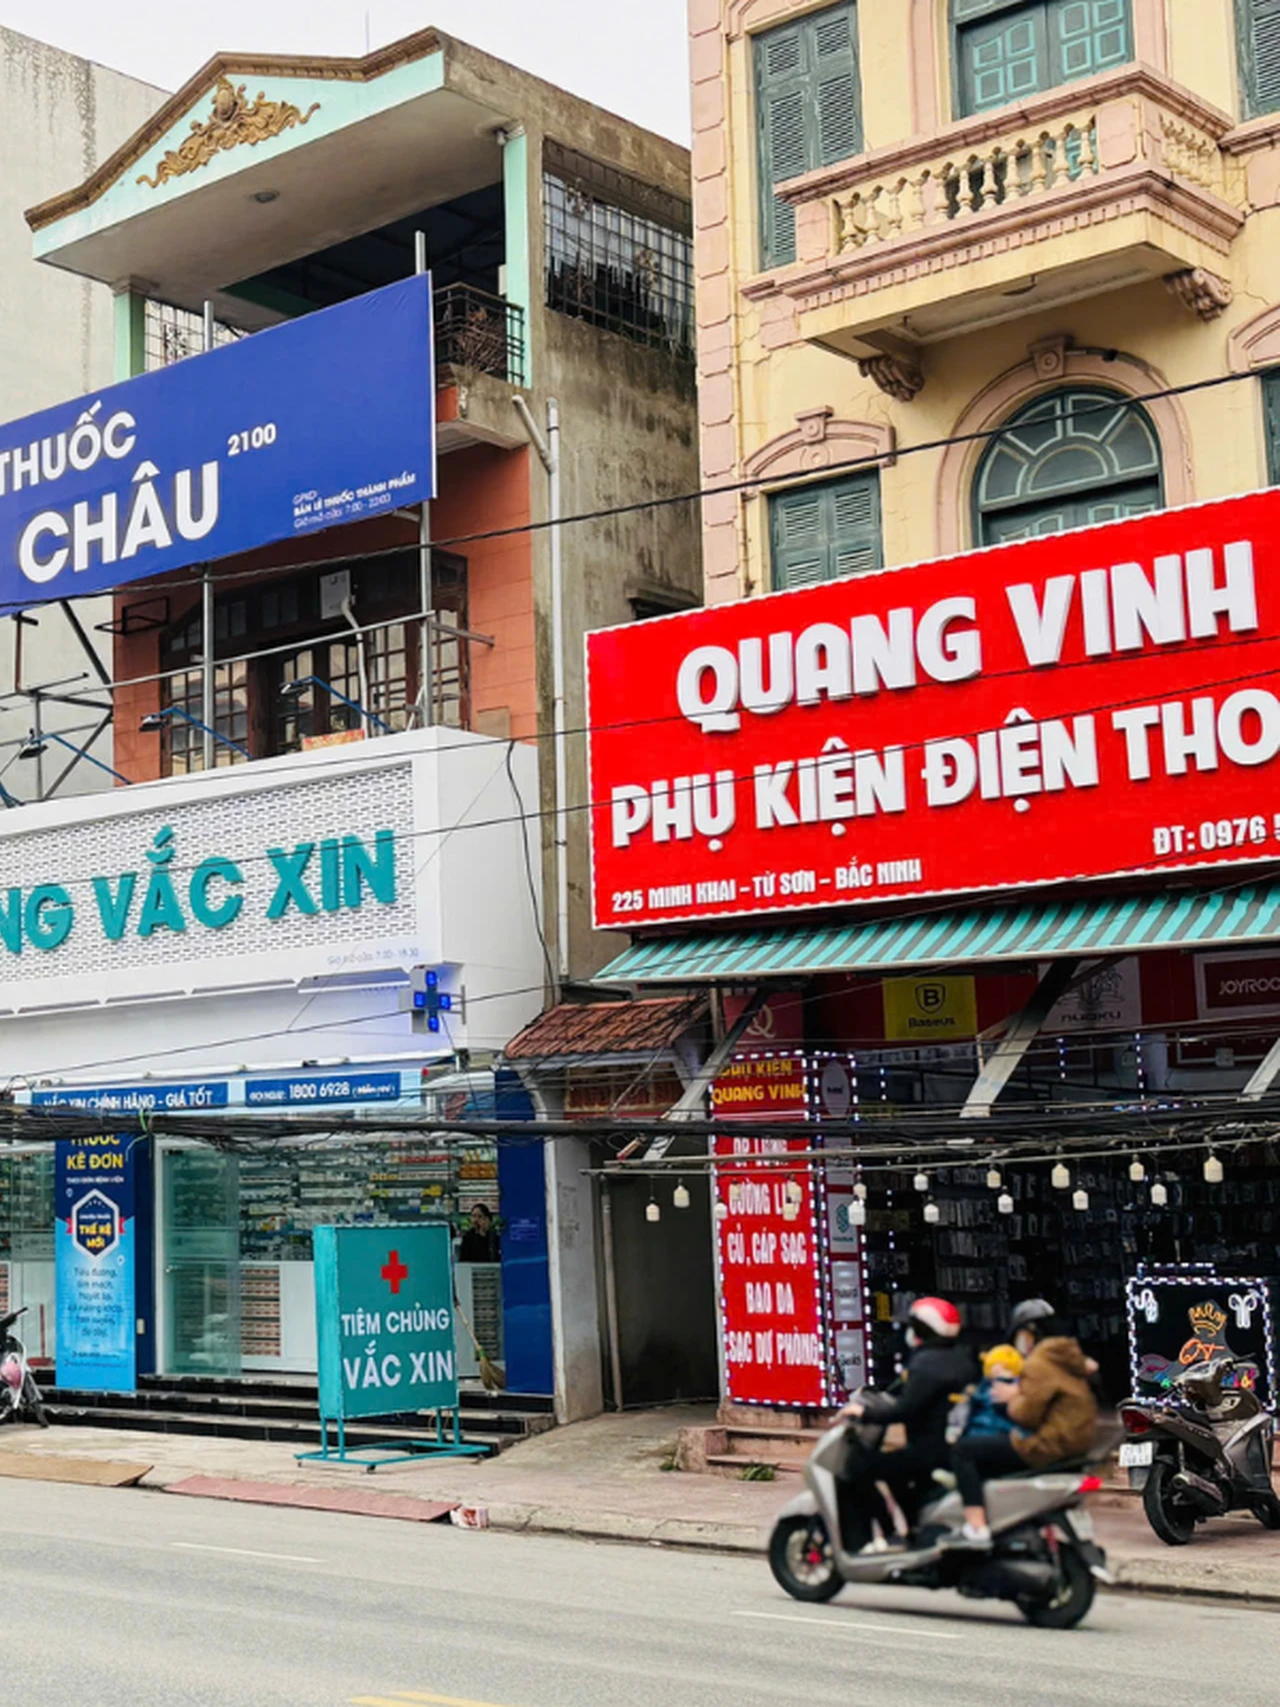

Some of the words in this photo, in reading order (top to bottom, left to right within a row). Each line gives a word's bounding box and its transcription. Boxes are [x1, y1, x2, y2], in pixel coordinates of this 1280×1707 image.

[228, 423, 277, 457] 2100
[18, 460, 220, 584] CHÂU
[677, 596, 982, 734] QUANG
[1006, 540, 1258, 665] VINH
[611, 769, 736, 852] PHỤ
[755, 737, 906, 836] KIỆN
[921, 708, 1099, 813] ĐIỆN
[1152, 824, 1196, 856] ĐT:
[1199, 814, 1267, 851] 0976
[92, 825, 245, 942] VẮC
[265, 828, 397, 920] XIN
[611, 890, 644, 912] 225
[648, 885, 694, 909] MINH
[696, 879, 737, 906] KHAI
[752, 868, 777, 898] TỪ
[779, 867, 816, 895] SƠN
[835, 855, 874, 890] BẮC
[877, 858, 922, 887] NINH
[908, 1016, 956, 1029] Baseus
[123, 1091, 156, 1111] HÃNG
[165, 1088, 187, 1107] GIÁ
[188, 1086, 213, 1105] TỐT
[289, 1083, 317, 1099] 1800
[319, 1081, 350, 1098] 6928
[711, 1084, 765, 1105] QUANG
[767, 1083, 808, 1100] VINH
[66, 1151, 86, 1170] KÊ
[89, 1151, 124, 1170] ĐƠN
[752, 1226, 777, 1265] CÁP
[780, 1231, 808, 1269] SẠC
[745, 1281, 773, 1314] BAO
[775, 1281, 795, 1315] DA
[341, 1308, 382, 1337] TIÊM
[386, 1302, 450, 1332] CHỦNG
[343, 1341, 403, 1389] VẮC
[409, 1349, 454, 1384] XIN
[728, 1331, 753, 1369] SẠC
[755, 1328, 774, 1370] DỰ
[776, 1325, 819, 1366] PHÒNG
